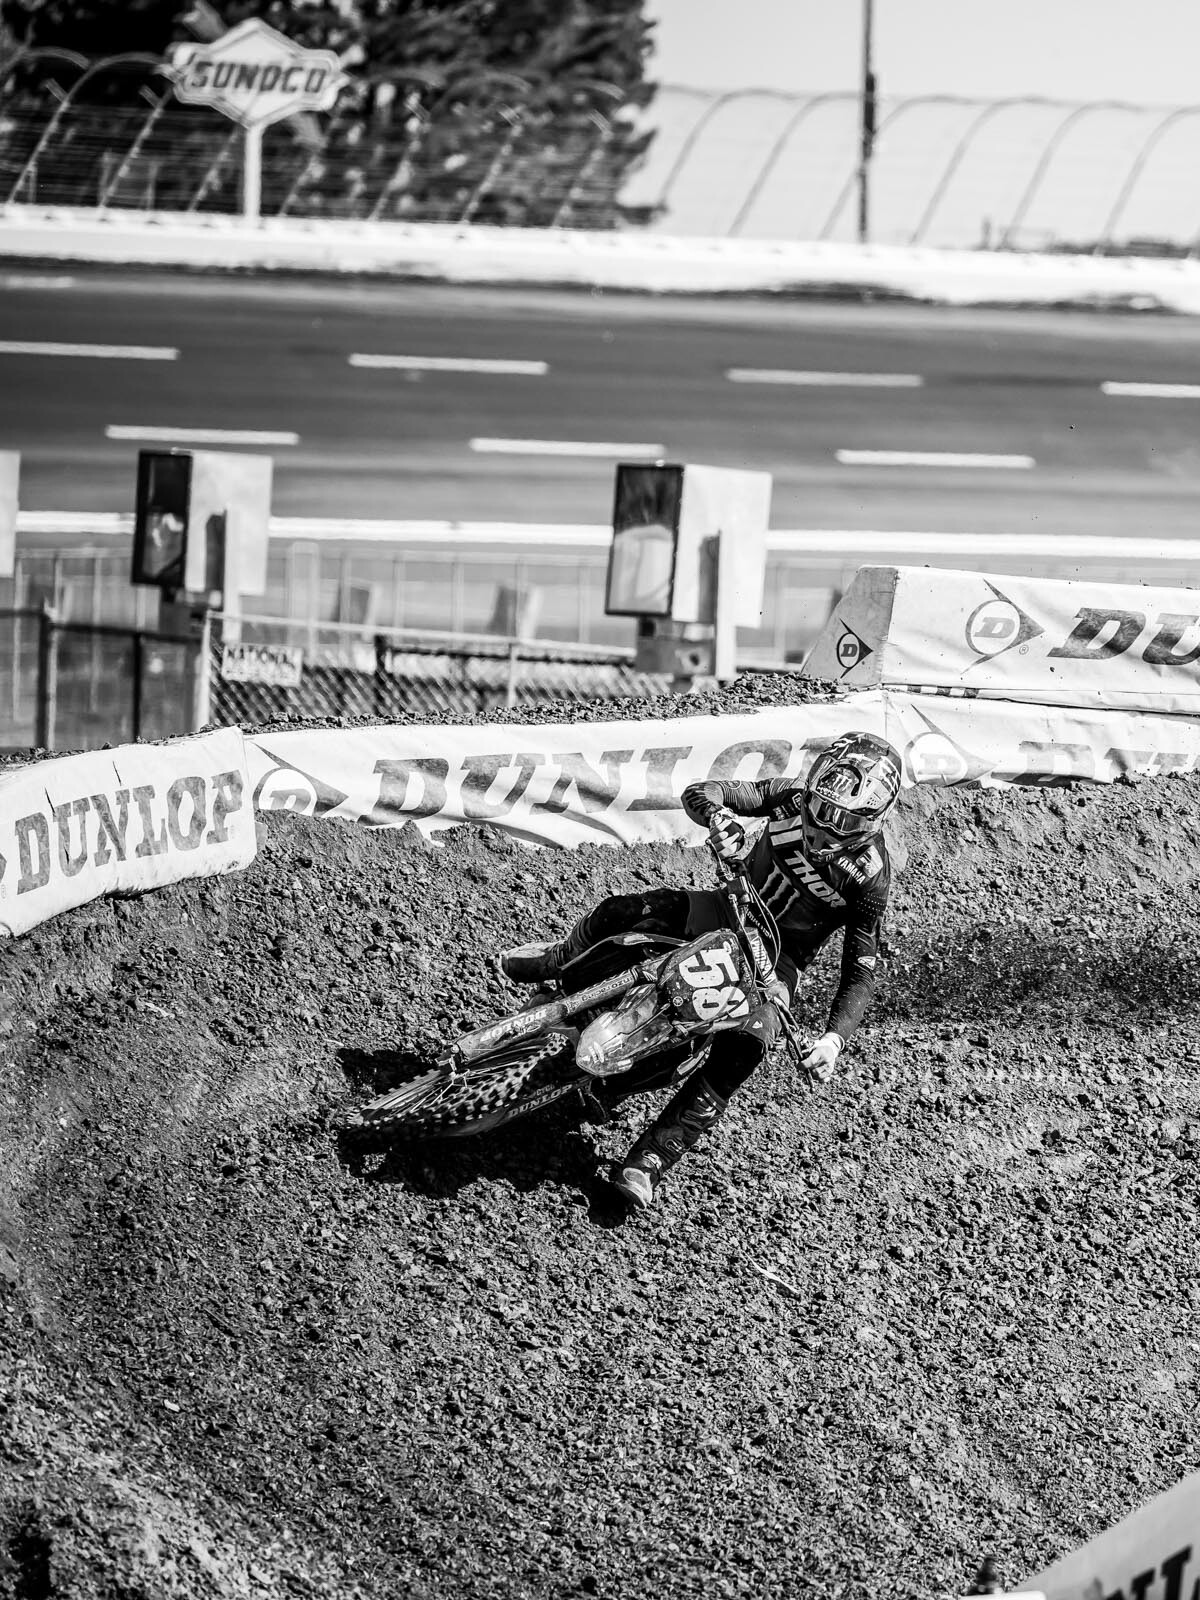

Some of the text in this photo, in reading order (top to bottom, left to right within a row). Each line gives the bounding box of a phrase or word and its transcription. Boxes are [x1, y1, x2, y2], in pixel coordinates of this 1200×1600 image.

[191, 60, 327, 94] SUNOCO
[973, 616, 1016, 639] D
[14, 769, 243, 895] DUNLOP
[785, 850, 847, 908] THOR
[837, 856, 867, 885] YAMAHA
[679, 941, 750, 1021] 58
[509, 1083, 573, 1118] DUNLOP
